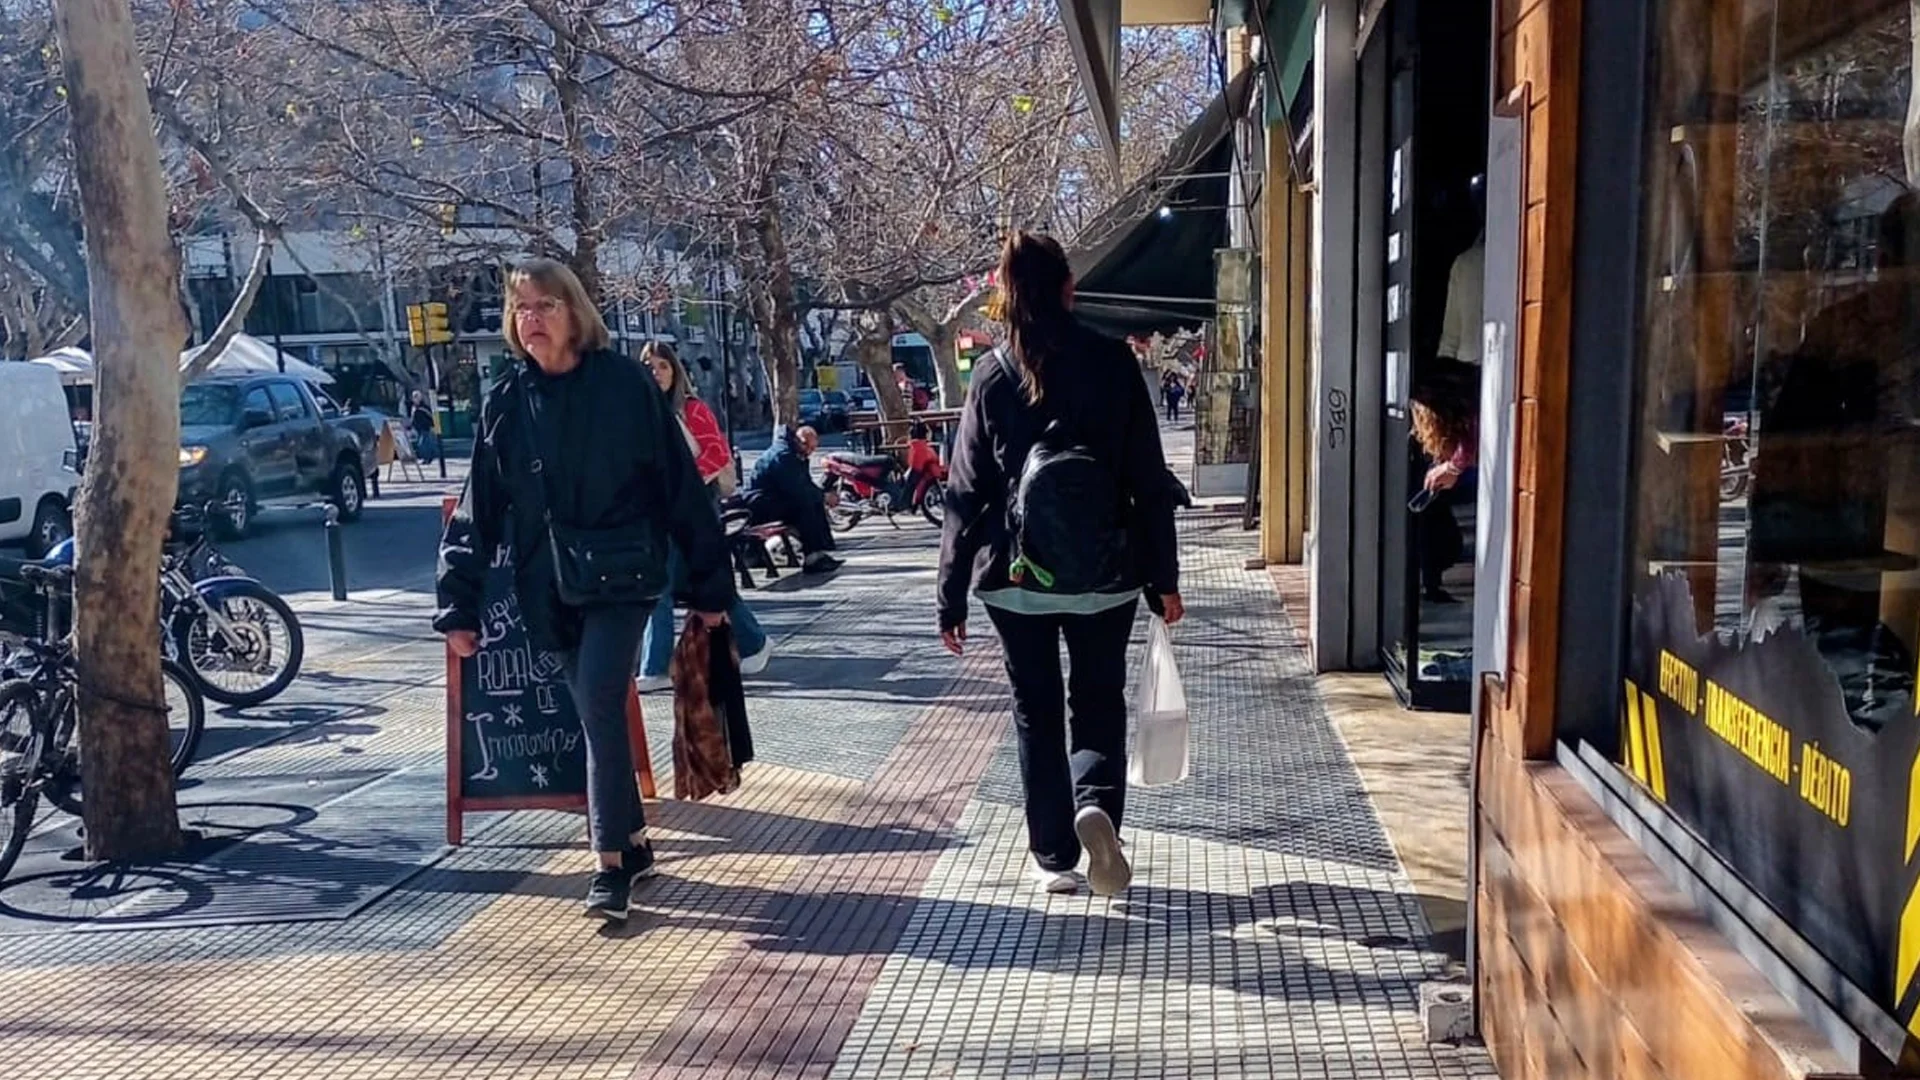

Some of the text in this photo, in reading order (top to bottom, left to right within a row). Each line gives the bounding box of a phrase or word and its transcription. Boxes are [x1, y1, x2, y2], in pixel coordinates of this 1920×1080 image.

[477, 647, 528, 691] ROPA
[536, 684, 560, 710] DE
[1659, 648, 1698, 716] EFECTIVO
[1705, 679, 1790, 785] TRANSFERENCIA
[1800, 740, 1850, 827] DÉBITO
